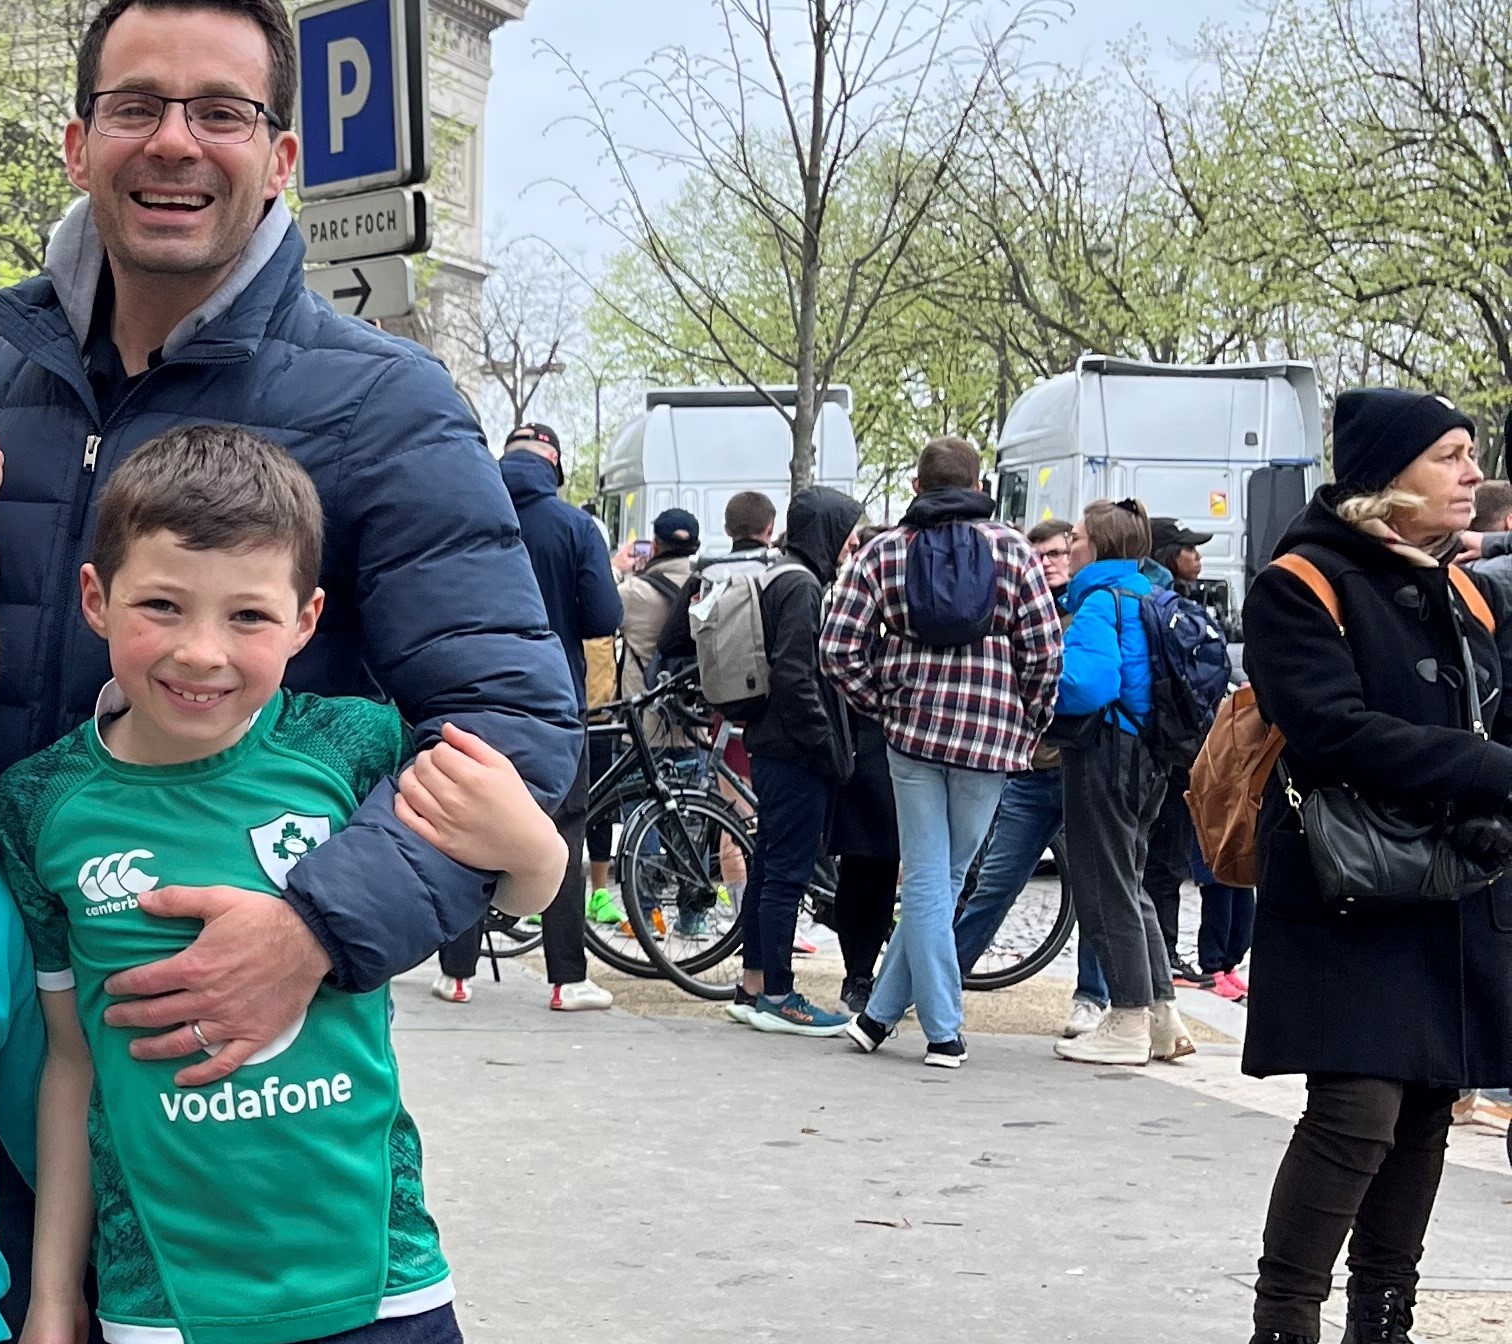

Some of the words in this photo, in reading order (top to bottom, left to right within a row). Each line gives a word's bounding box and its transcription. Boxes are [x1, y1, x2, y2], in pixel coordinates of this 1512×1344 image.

[327, 36, 372, 155] P
[310, 218, 349, 244] PARC
[355, 209, 397, 236] FOCH
[85, 895, 139, 917] canterb
[159, 1072, 353, 1124] vodafone
